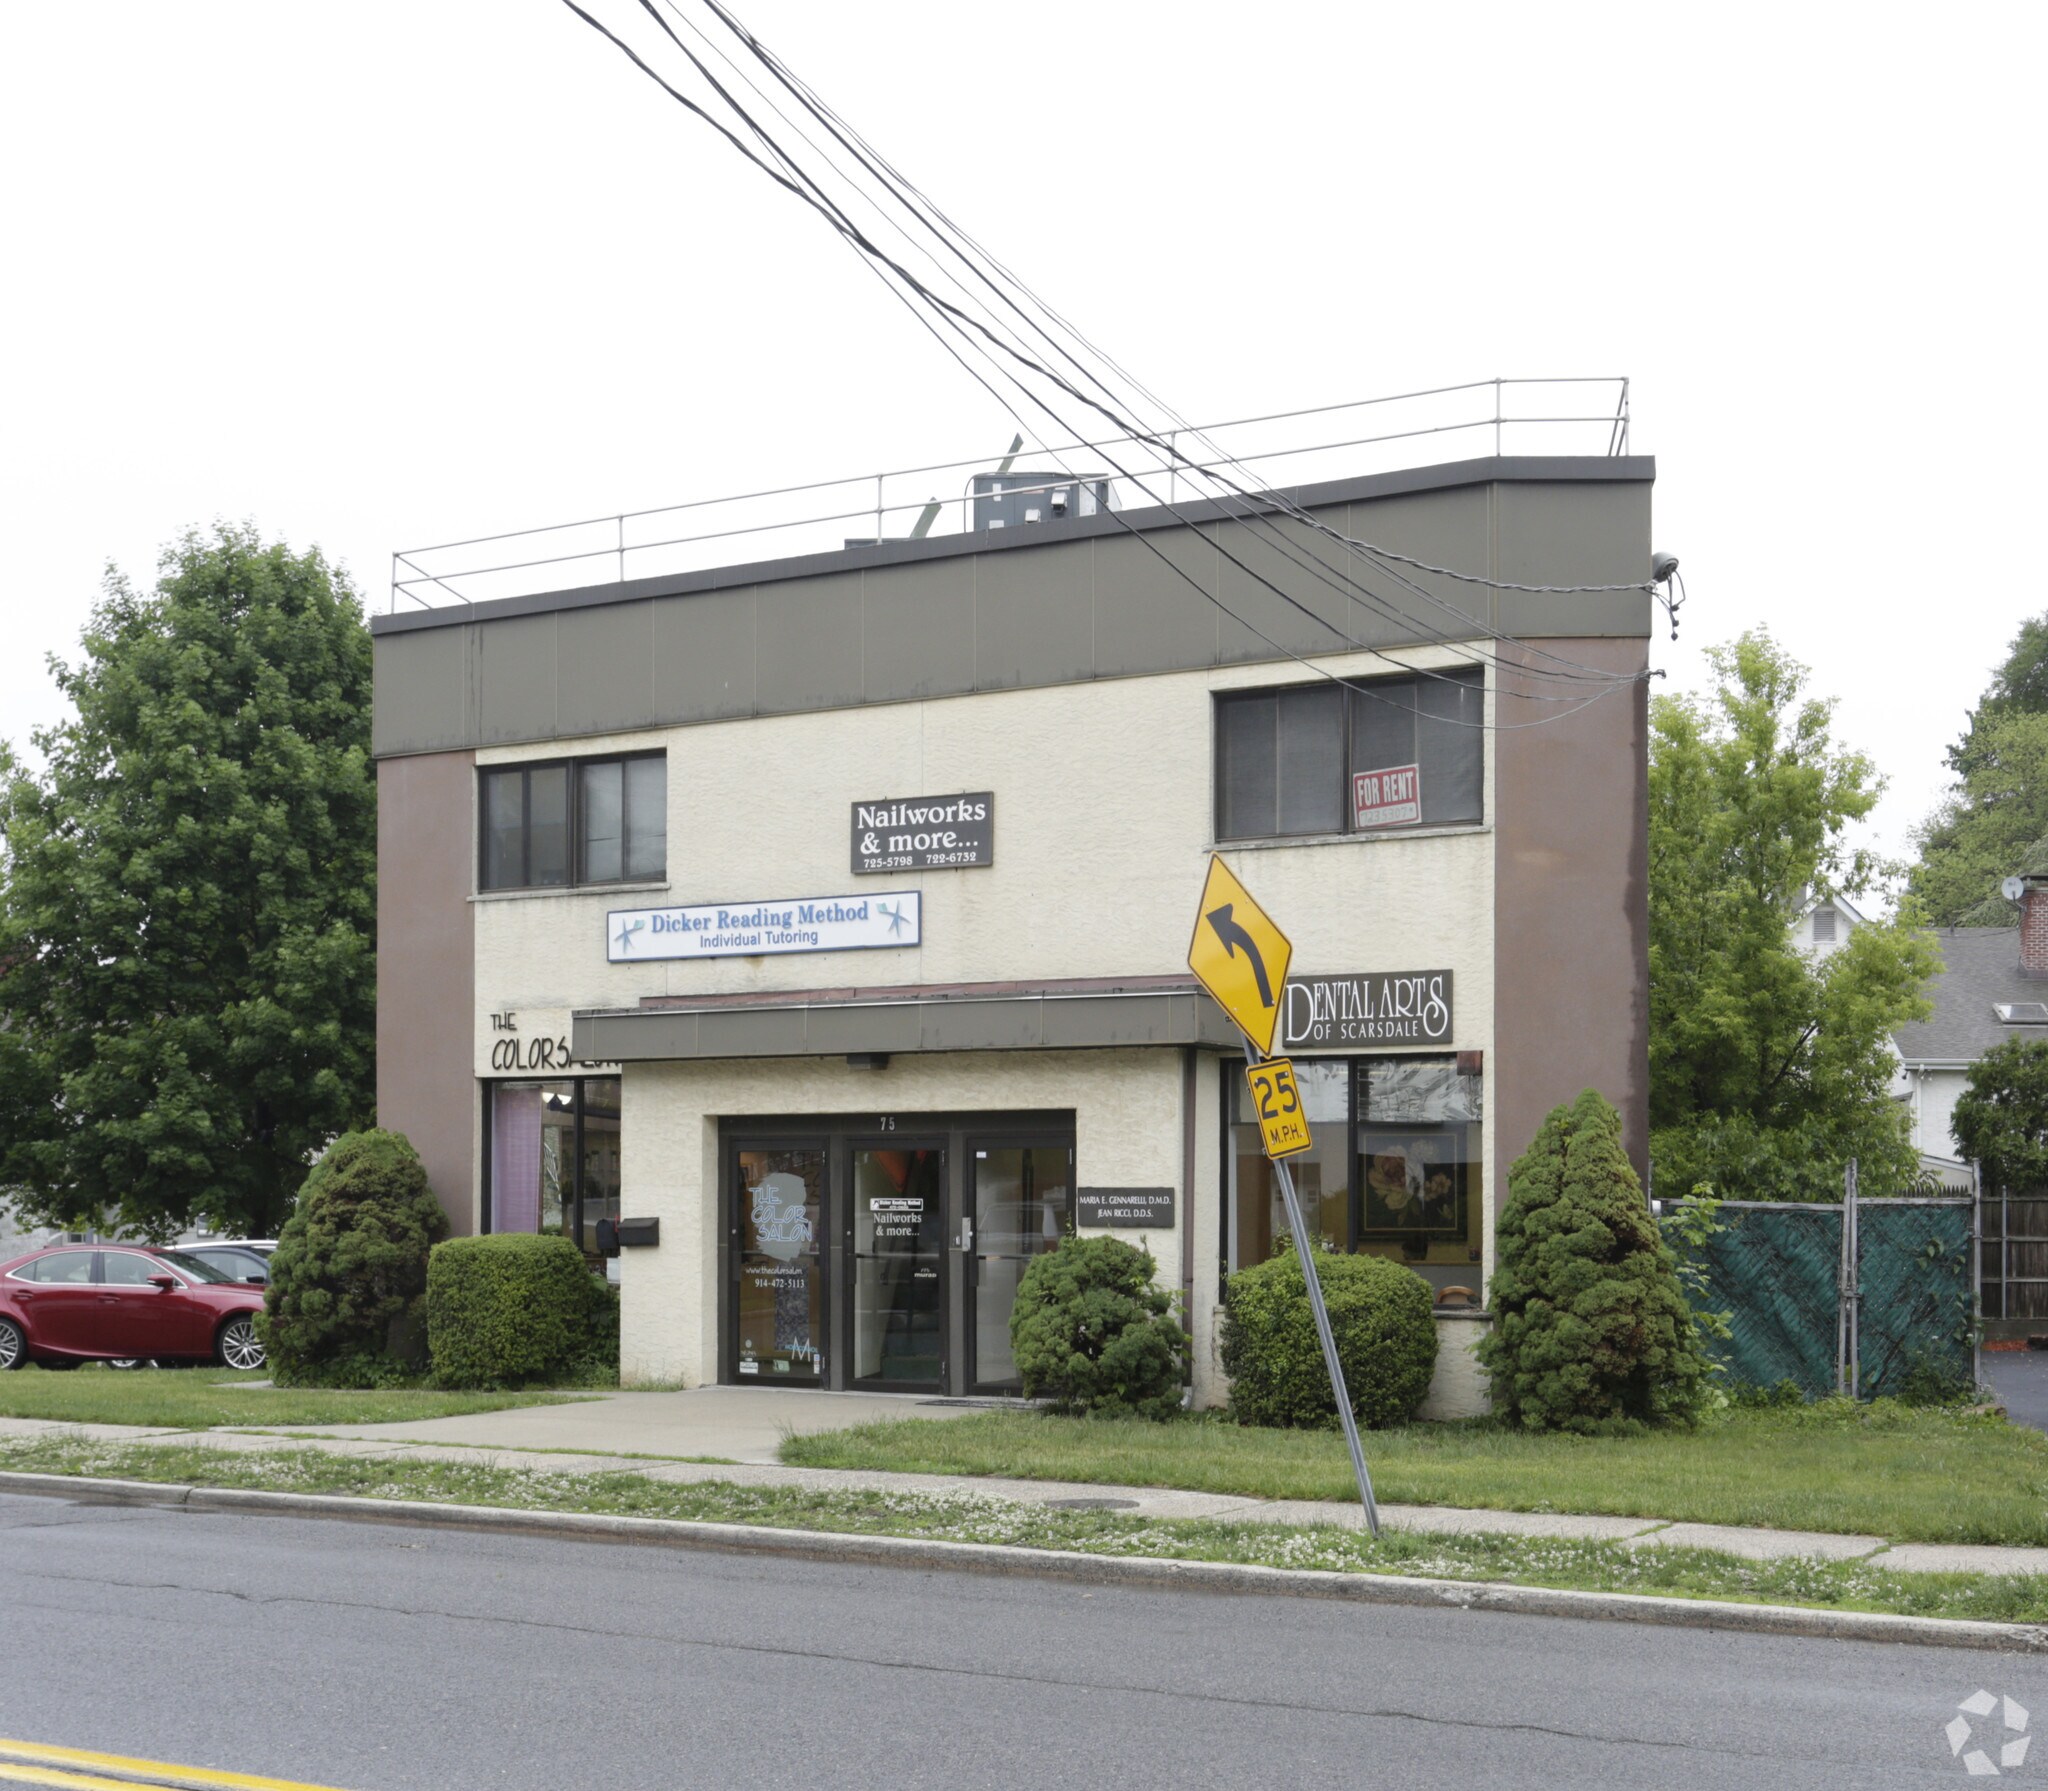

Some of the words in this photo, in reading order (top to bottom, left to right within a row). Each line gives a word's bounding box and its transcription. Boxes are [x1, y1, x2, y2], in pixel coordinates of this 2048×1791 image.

[1357, 777, 1380, 807] FOR
[1382, 771, 1414, 803] RENT
[857, 799, 986, 829] Nailworks
[860, 832, 881, 855] &
[888, 831, 978, 852] more...
[864, 856, 913, 868] 725-5798
[926, 851, 977, 864] 722-6732
[651, 912, 712, 934] Dicker
[717, 907, 793, 930] Reading
[798, 900, 869, 925] Method
[700, 931, 761, 948] Individual
[765, 929, 818, 946] Tutoring
[1285, 980, 1375, 1042] DENTAL
[1378, 975, 1449, 1037] ARTS
[490, 1011, 518, 1031] THE
[1313, 1023, 1332, 1040] OF
[1340, 1020, 1419, 1039] SCARSDALE
[1254, 1071, 1298, 1120] 25
[880, 1116, 895, 1131] 75
[749, 1184, 783, 1208] THE
[1079, 1195, 1100, 1205] MARIA
[1101, 1195, 1108, 1205] E.
[751, 1204, 809, 1224] COLOR
[873, 1212, 922, 1224] Nailworks
[1097, 1208, 1113, 1219] JEAN
[755, 1221, 813, 1242] SALON
[875, 1225, 884, 1236] &
[754, 1278, 805, 1289] 914-472-5113
